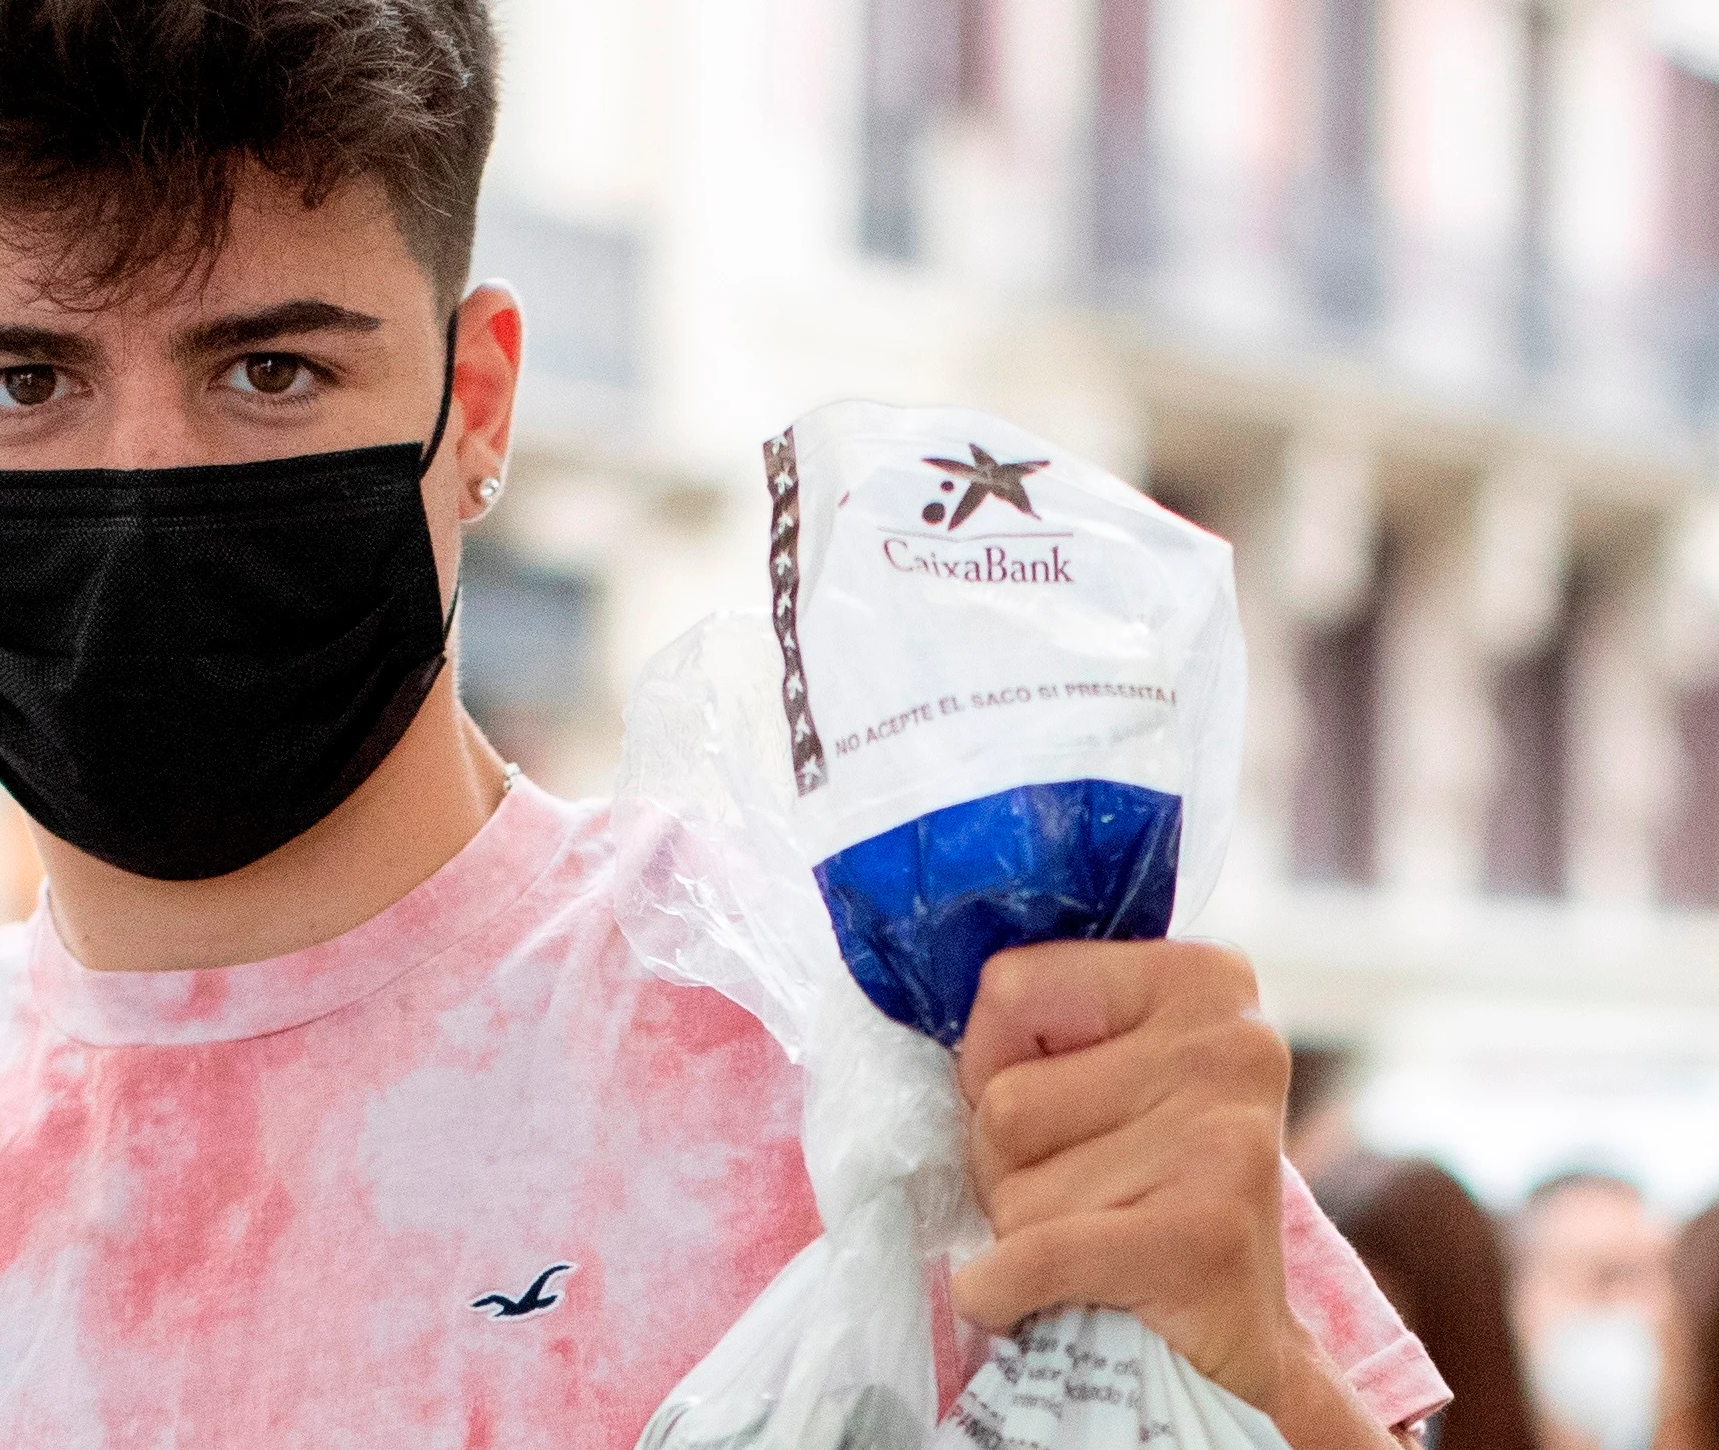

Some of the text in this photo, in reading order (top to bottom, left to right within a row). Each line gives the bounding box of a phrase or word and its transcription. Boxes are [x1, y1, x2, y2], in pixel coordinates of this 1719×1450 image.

[883, 537, 1074, 584] CaixaBank
[835, 733, 861, 757] NO
[865, 703, 934, 745] ACEPTE
[938, 695, 965, 717] EL
[970, 685, 1033, 710] SACO
[1038, 684, 1060, 700] SI
